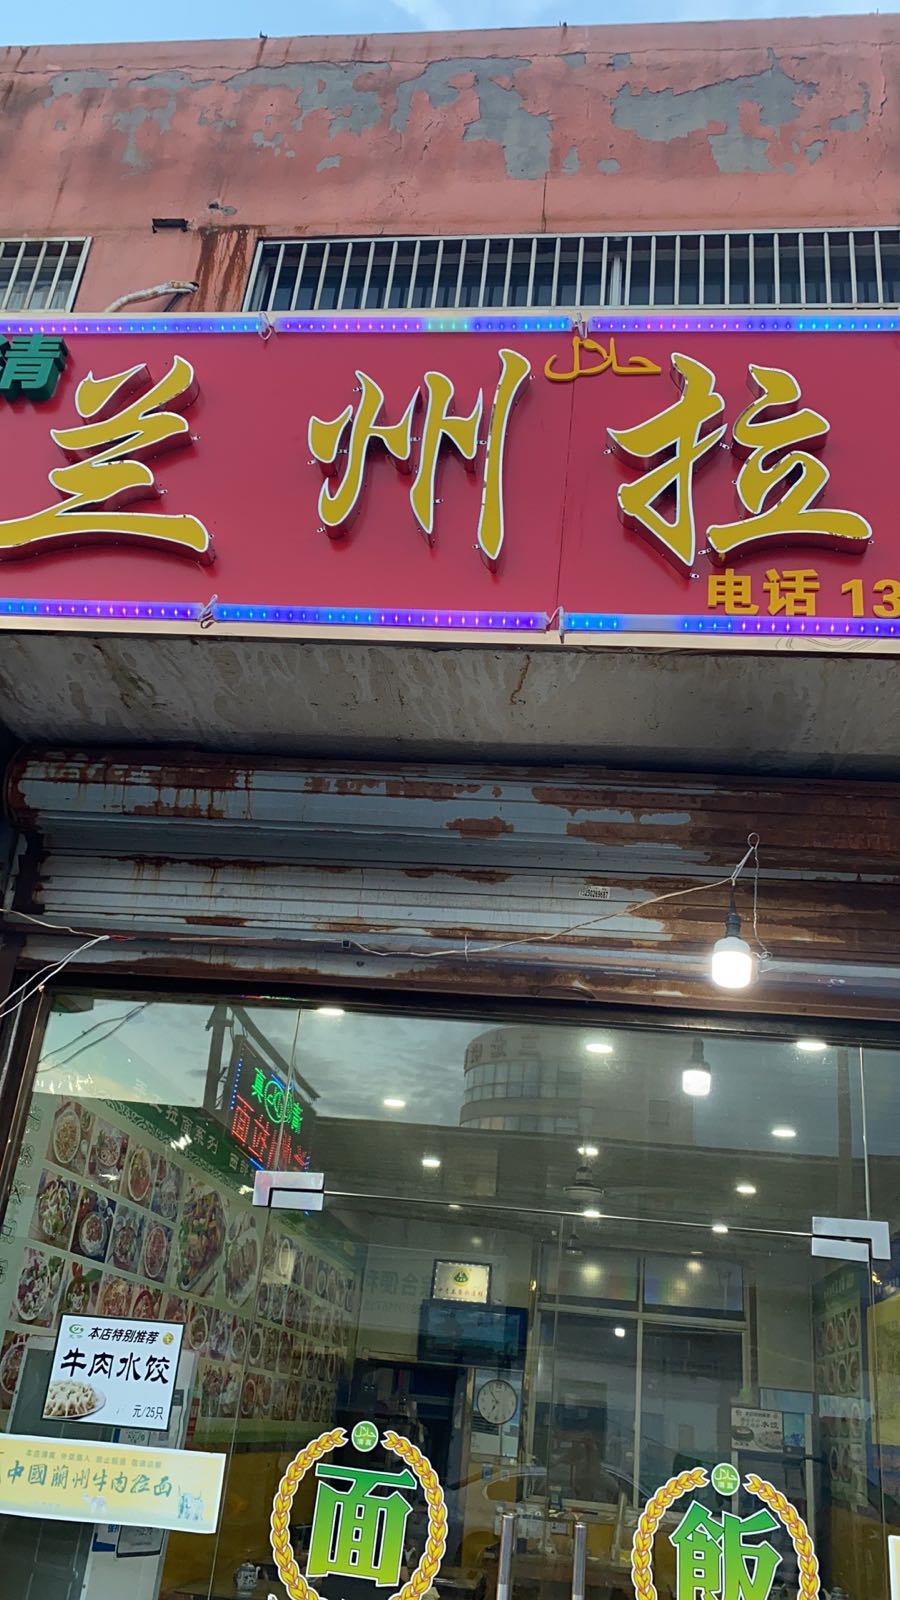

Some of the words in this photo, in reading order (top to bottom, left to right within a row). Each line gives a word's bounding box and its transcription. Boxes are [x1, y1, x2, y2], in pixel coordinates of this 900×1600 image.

[544, 336, 661, 381] حلال
[708, 568, 820, 616] 电话
[841, 579, 900, 618] 13
[88, 1326, 159, 1344] 本店特别推荐
[60, 1347, 170, 1384] 牛肉水饺
[132, 1404, 164, 1420] 元/25只
[306, 1463, 417, 1587] 面
